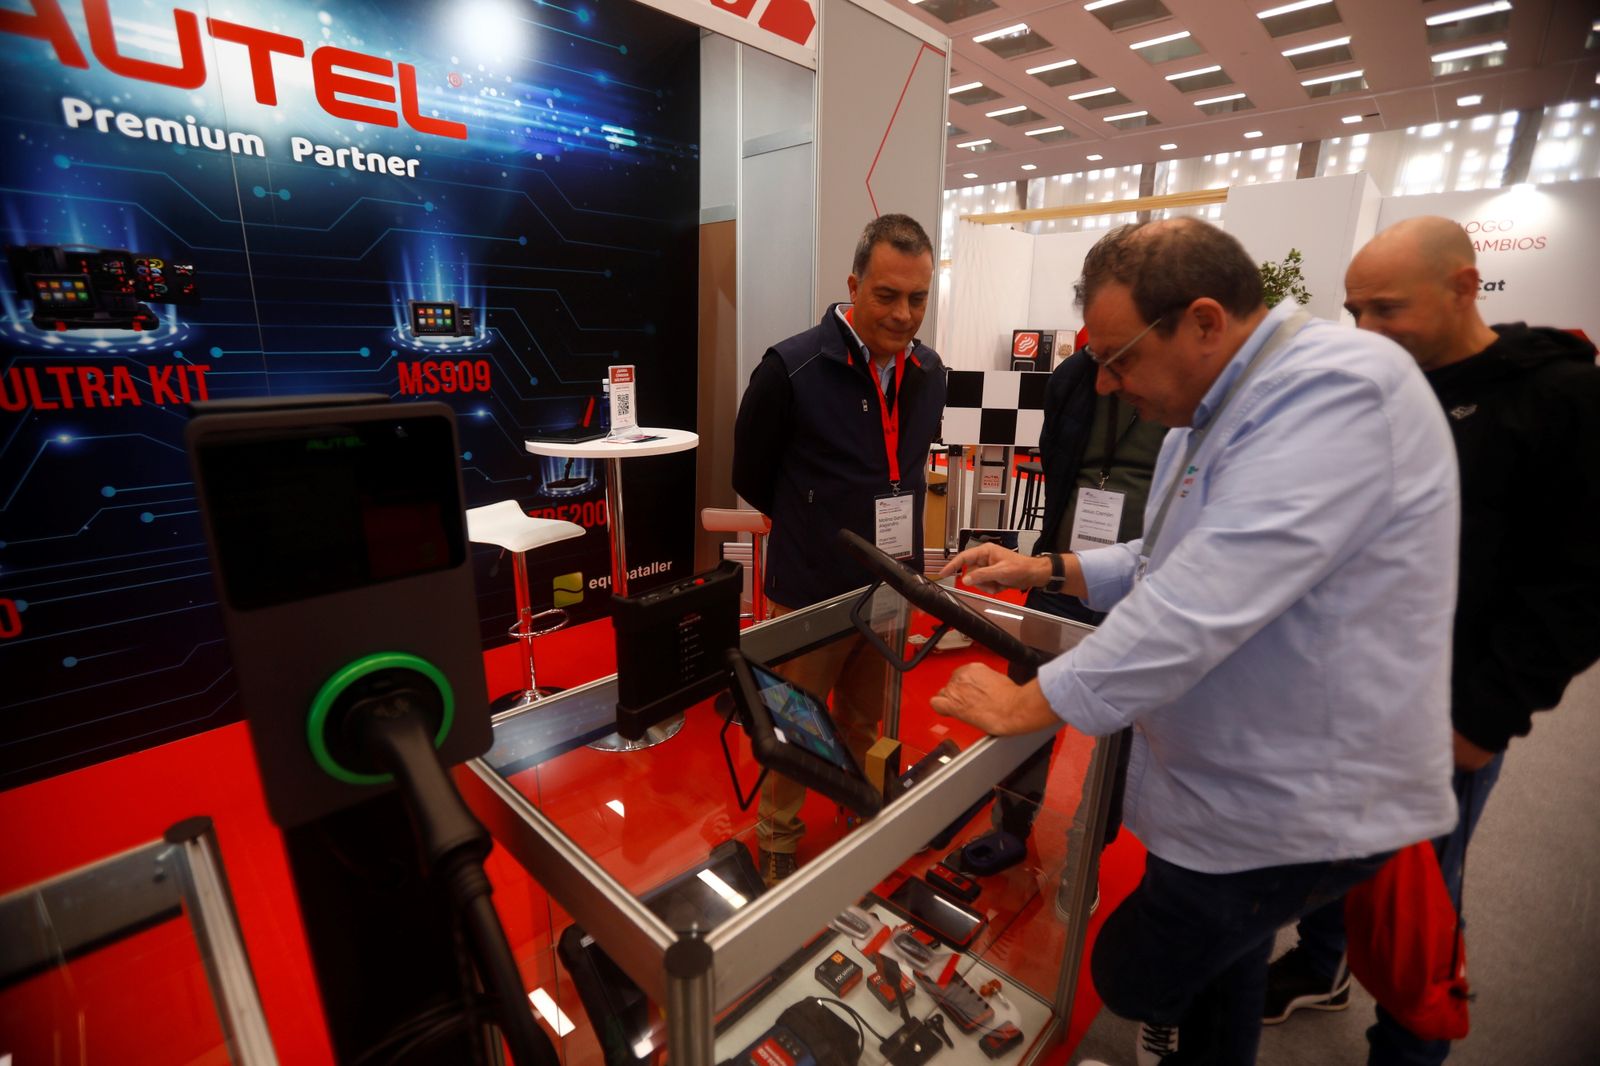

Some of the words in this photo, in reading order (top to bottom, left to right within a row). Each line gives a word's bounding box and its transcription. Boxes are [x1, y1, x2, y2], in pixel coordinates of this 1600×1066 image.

[61, 97, 266, 158] Premium
[290, 136, 420, 178] Partner
[1472, 236, 1547, 253] AMBIOS
[0, 365, 142, 412] ULTRA
[148, 364, 211, 405] KIT
[399, 359, 492, 395] MS909
